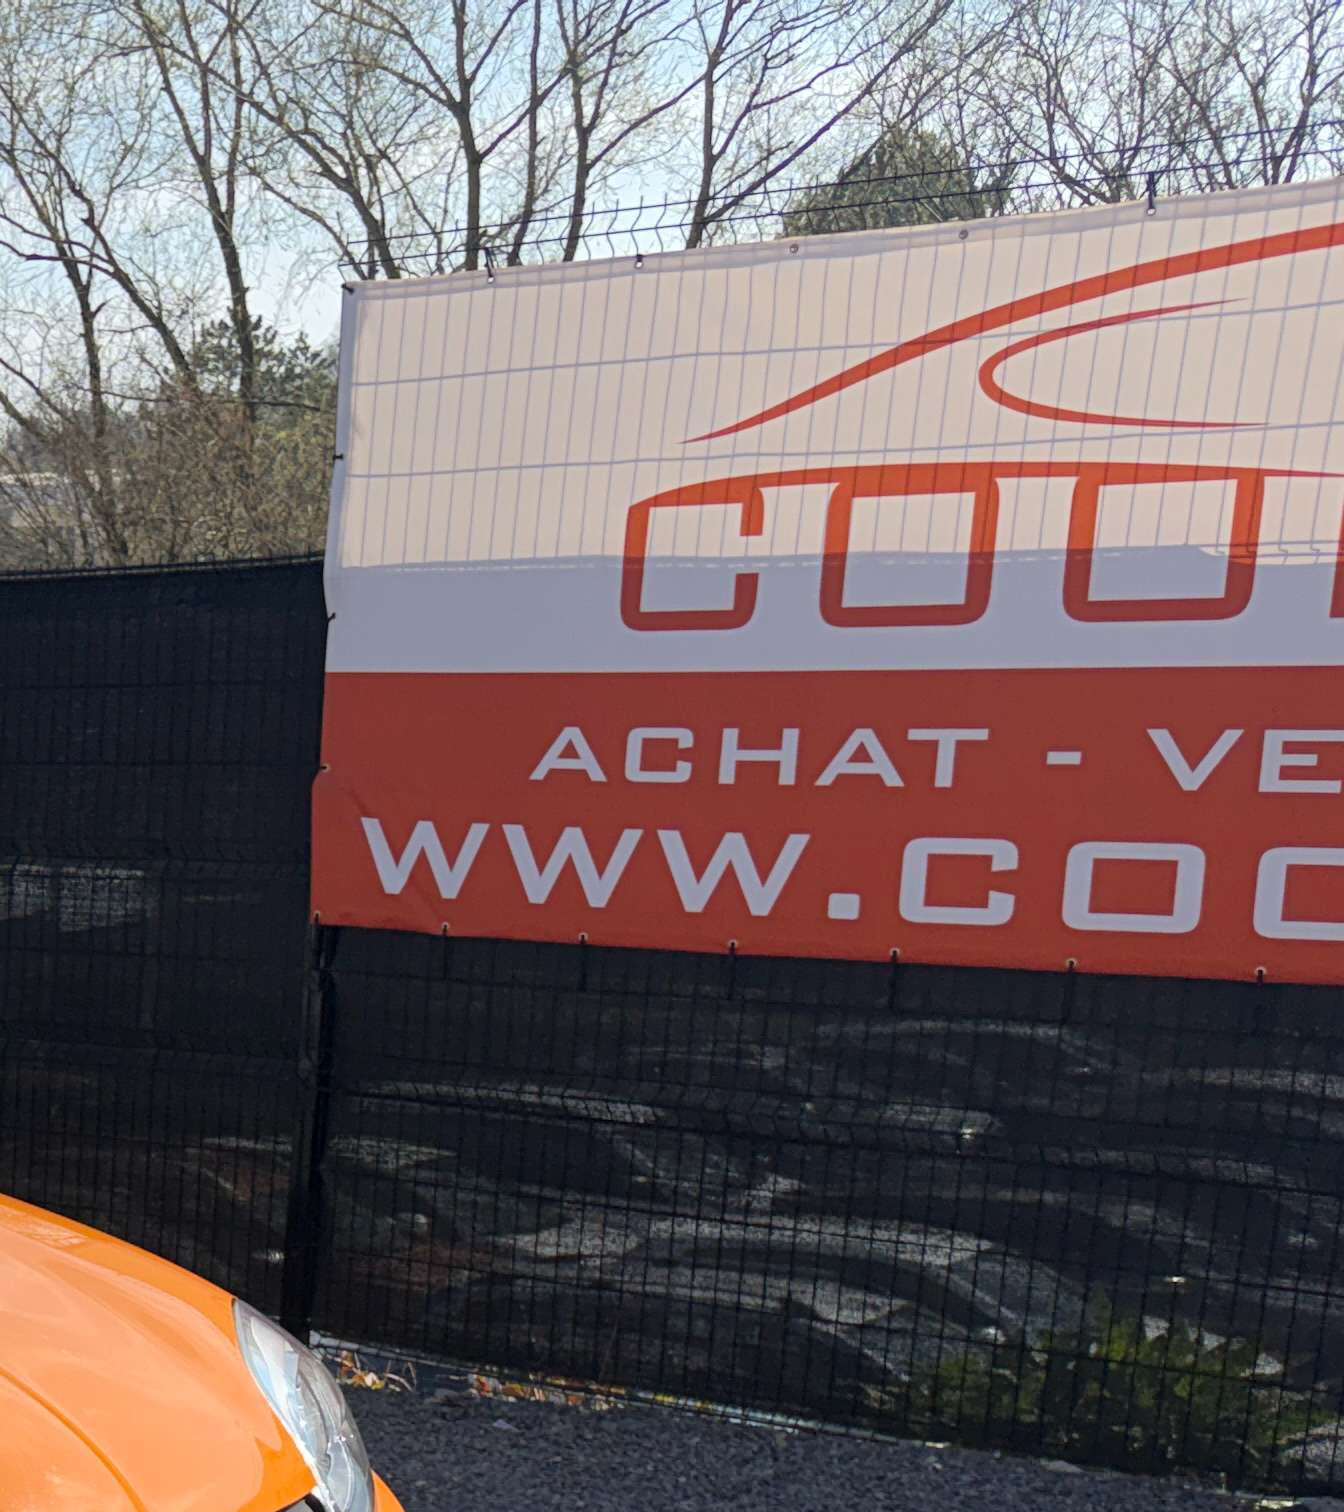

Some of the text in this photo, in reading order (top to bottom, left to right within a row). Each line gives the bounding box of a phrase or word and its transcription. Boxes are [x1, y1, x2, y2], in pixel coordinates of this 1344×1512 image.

[620, 461, 1344, 631] COO
[528, 725, 1344, 794] ACHAT - VE
